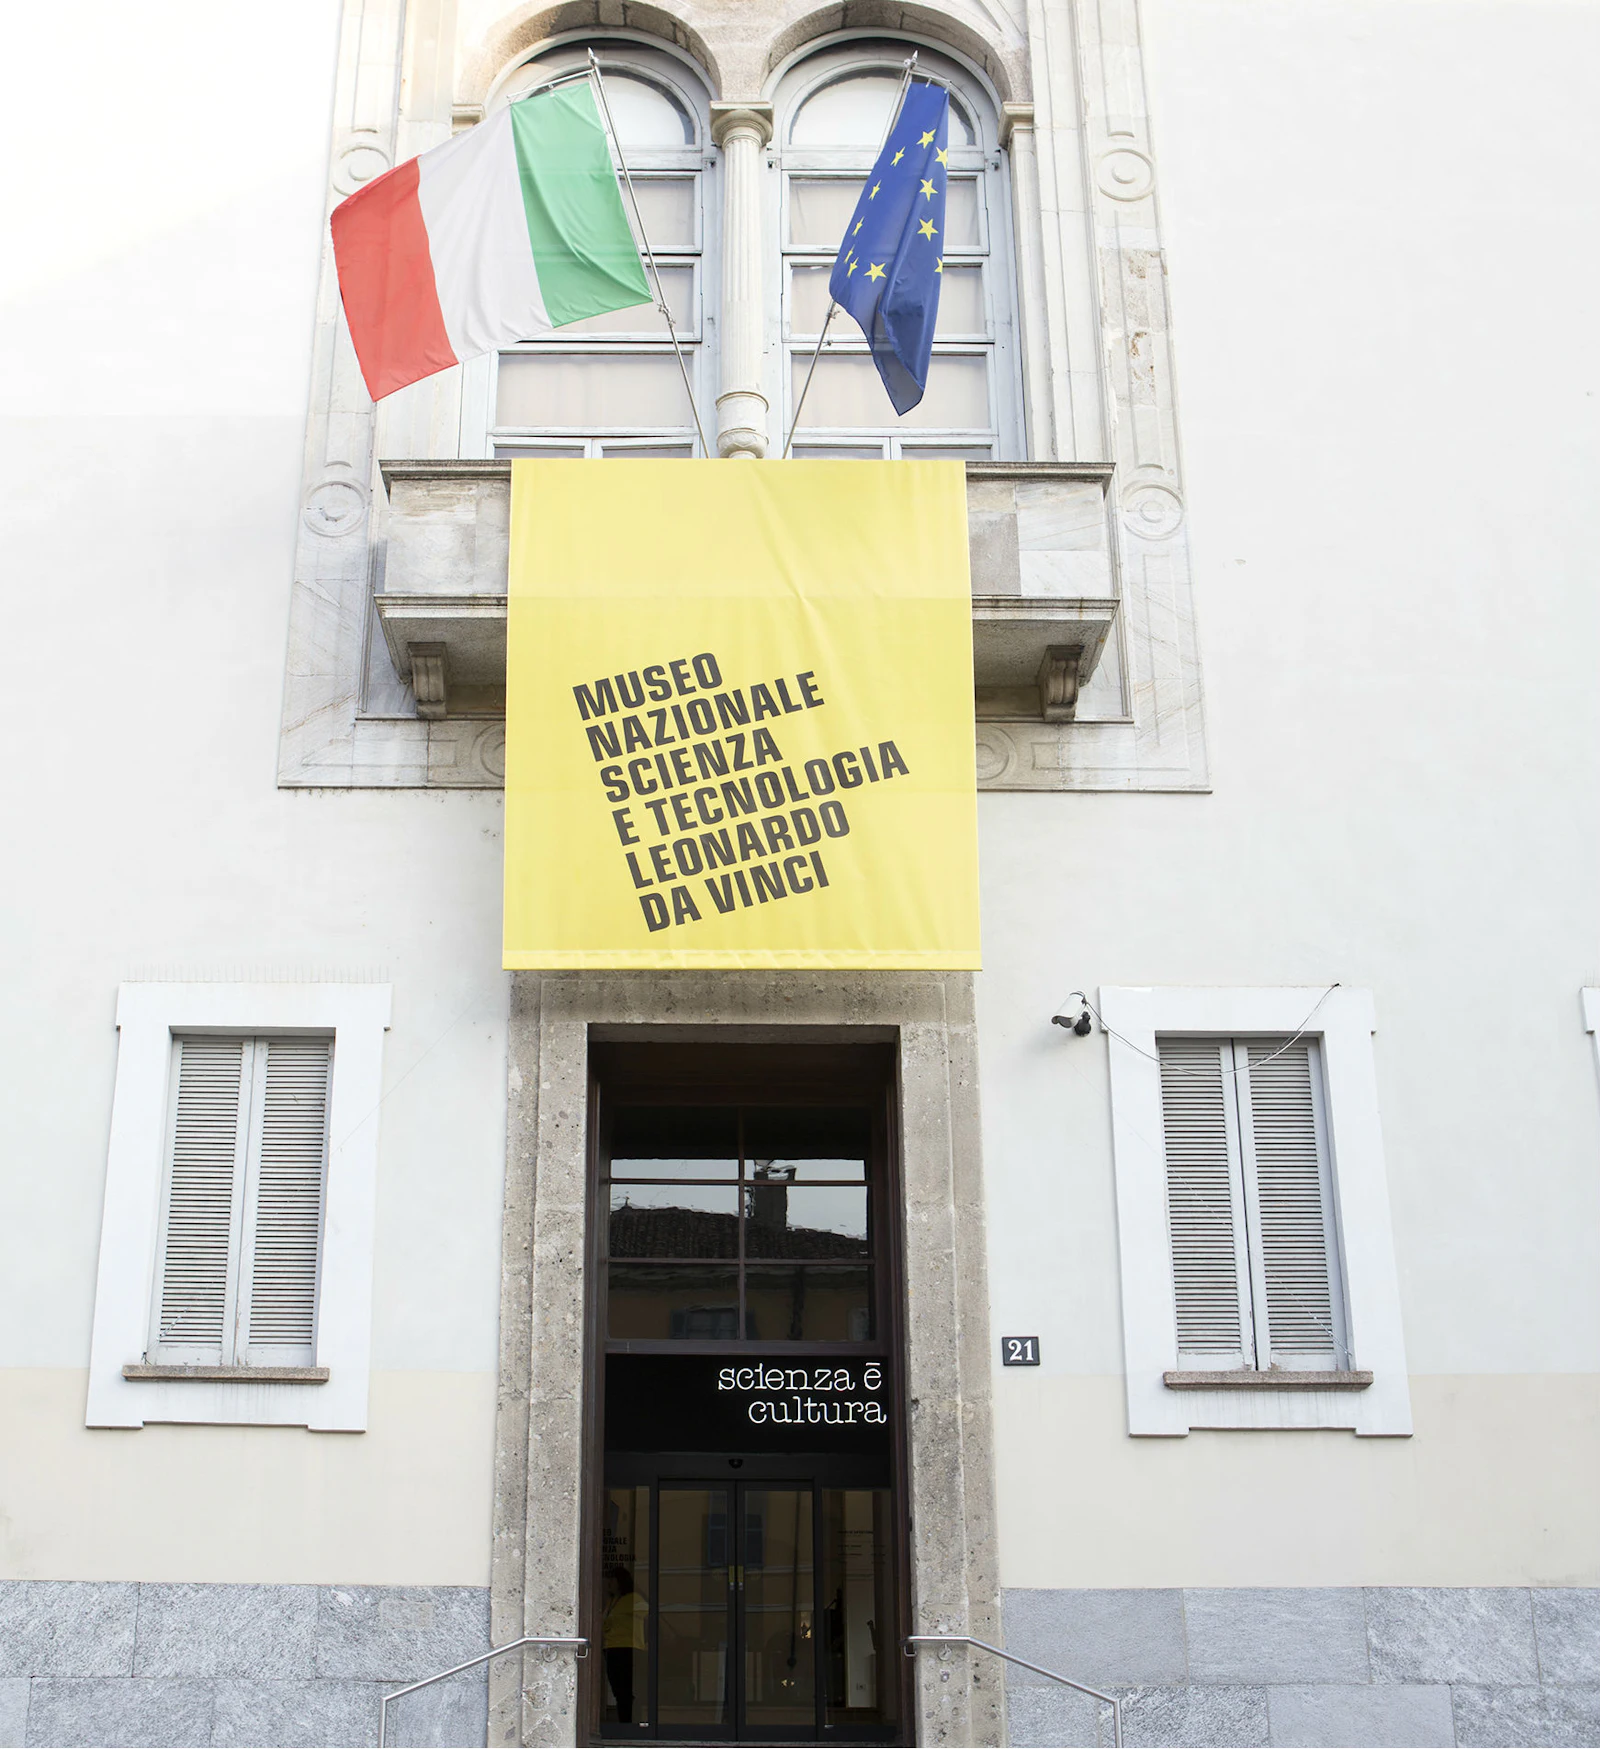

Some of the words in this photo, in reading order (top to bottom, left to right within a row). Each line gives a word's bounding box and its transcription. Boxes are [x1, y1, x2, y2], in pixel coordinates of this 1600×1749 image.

[573, 653, 722, 720] MUSEO
[586, 671, 824, 762] NAZIONALE
[601, 728, 783, 802] SCIENZA
[612, 808, 640, 846] E
[645, 741, 909, 836] TECNOLOGIA
[626, 801, 849, 889] LEONARDO
[639, 885, 702, 932] DA
[704, 851, 829, 914] VINCI
[718, 1362, 855, 1391] scienza
[1008, 1339, 1034, 1361] 21
[748, 1396, 887, 1424] cultura
